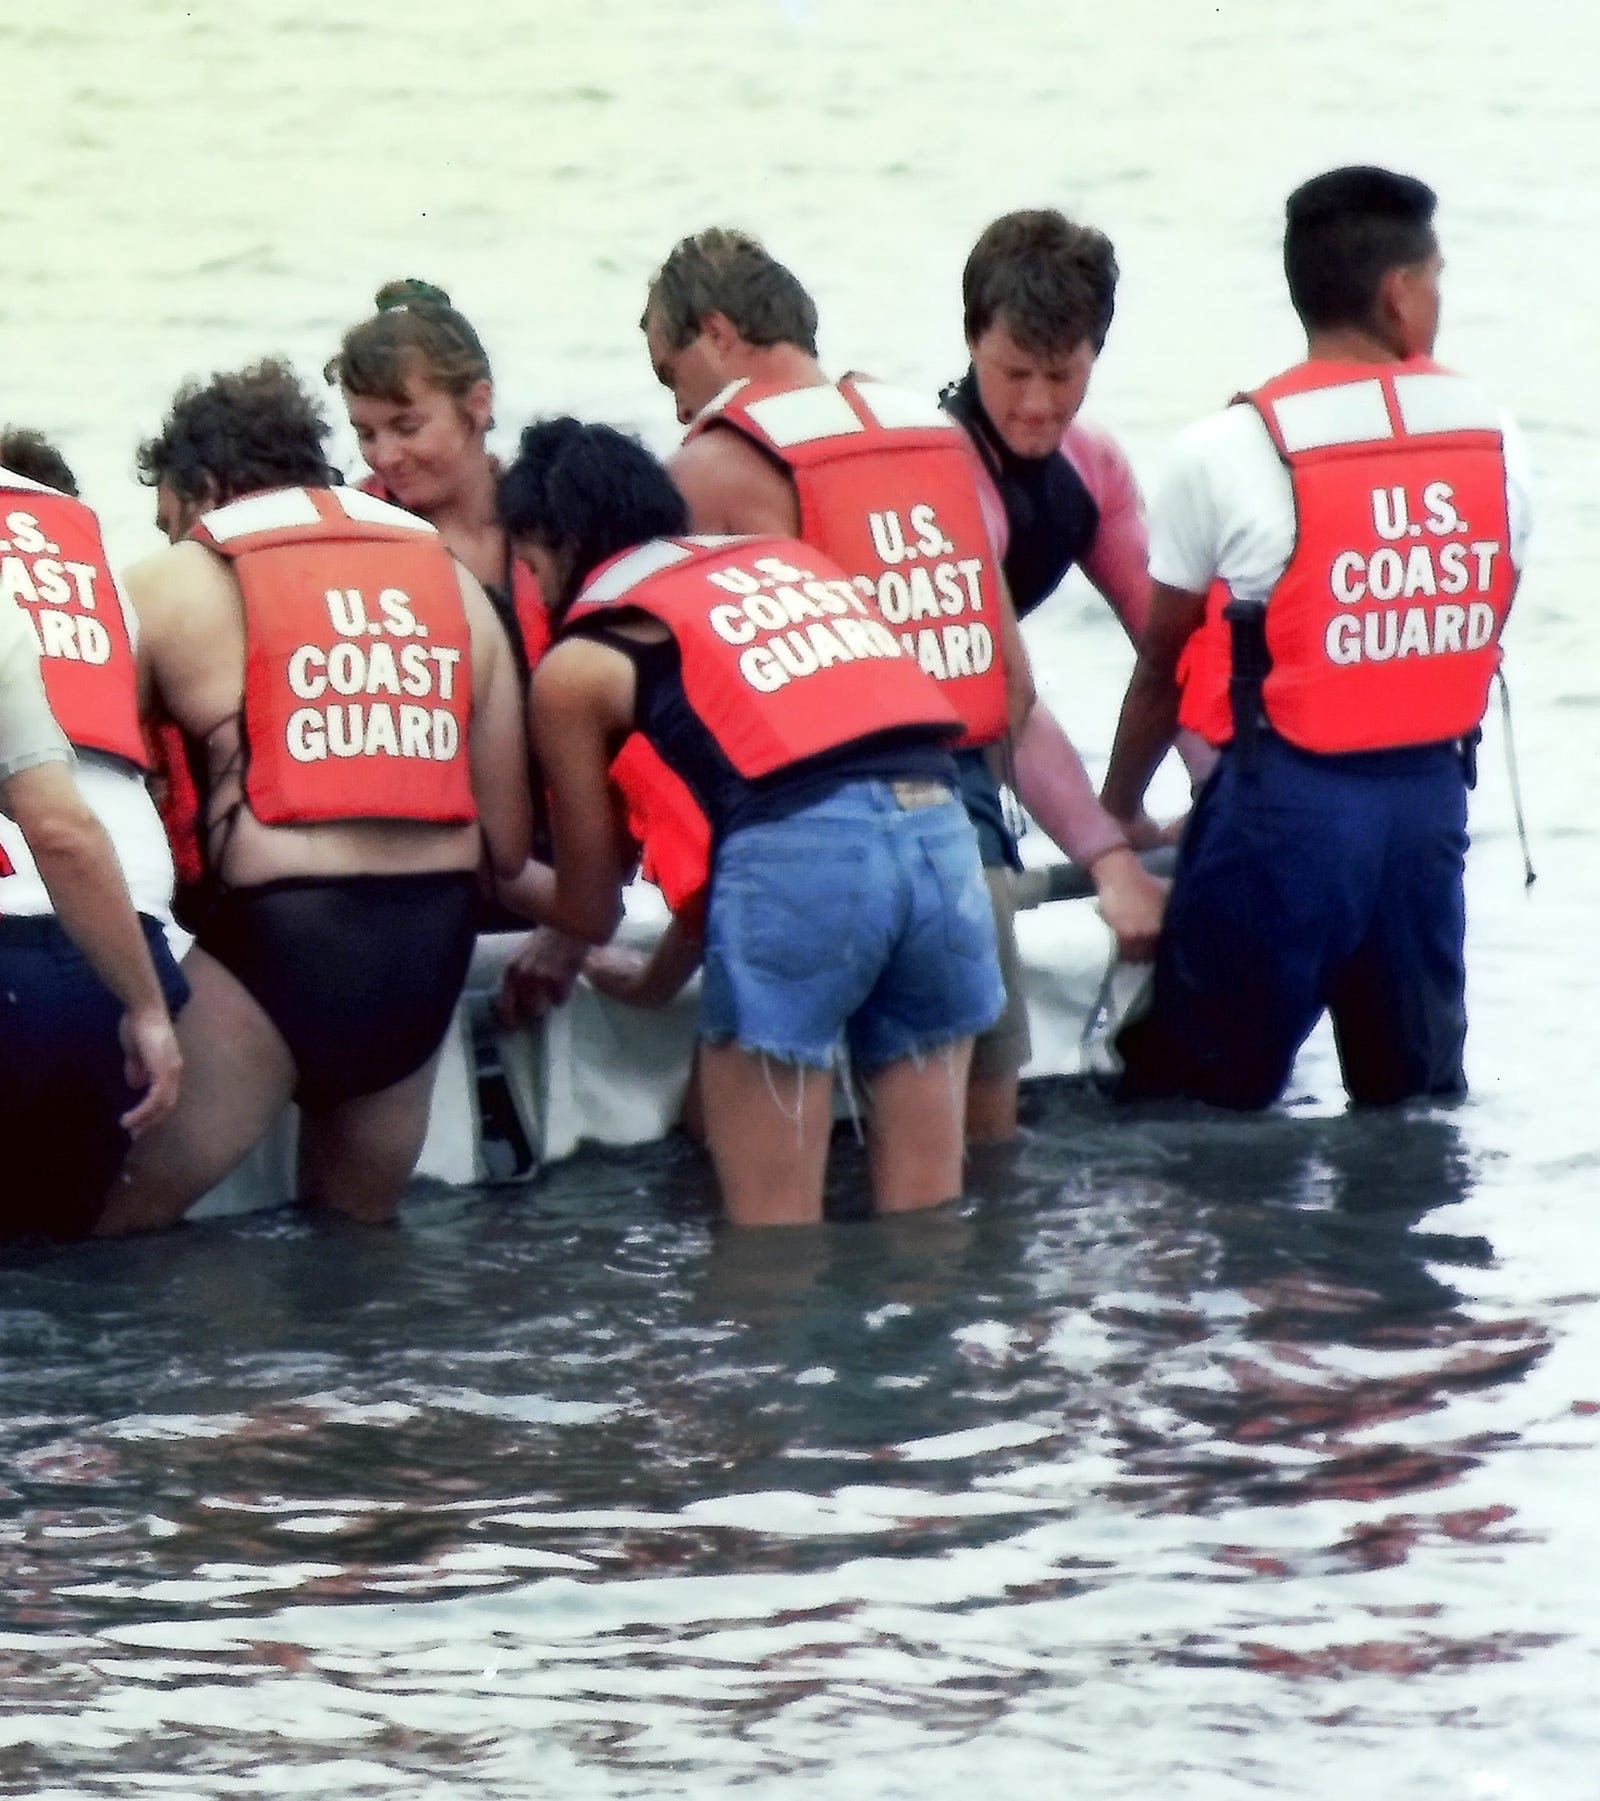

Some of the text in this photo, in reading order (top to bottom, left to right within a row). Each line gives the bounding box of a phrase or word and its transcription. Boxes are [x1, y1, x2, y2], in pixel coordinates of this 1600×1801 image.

[867, 503, 956, 565] U.S.
[1371, 481, 1470, 541] U.S.
[706, 556, 816, 595] U.S.
[1329, 541, 1500, 605] COAST
[323, 587, 429, 638] U.S.
[1324, 601, 1496, 666] GUARD
[287, 641, 461, 700] COAST
[285, 702, 460, 763] GUARD
